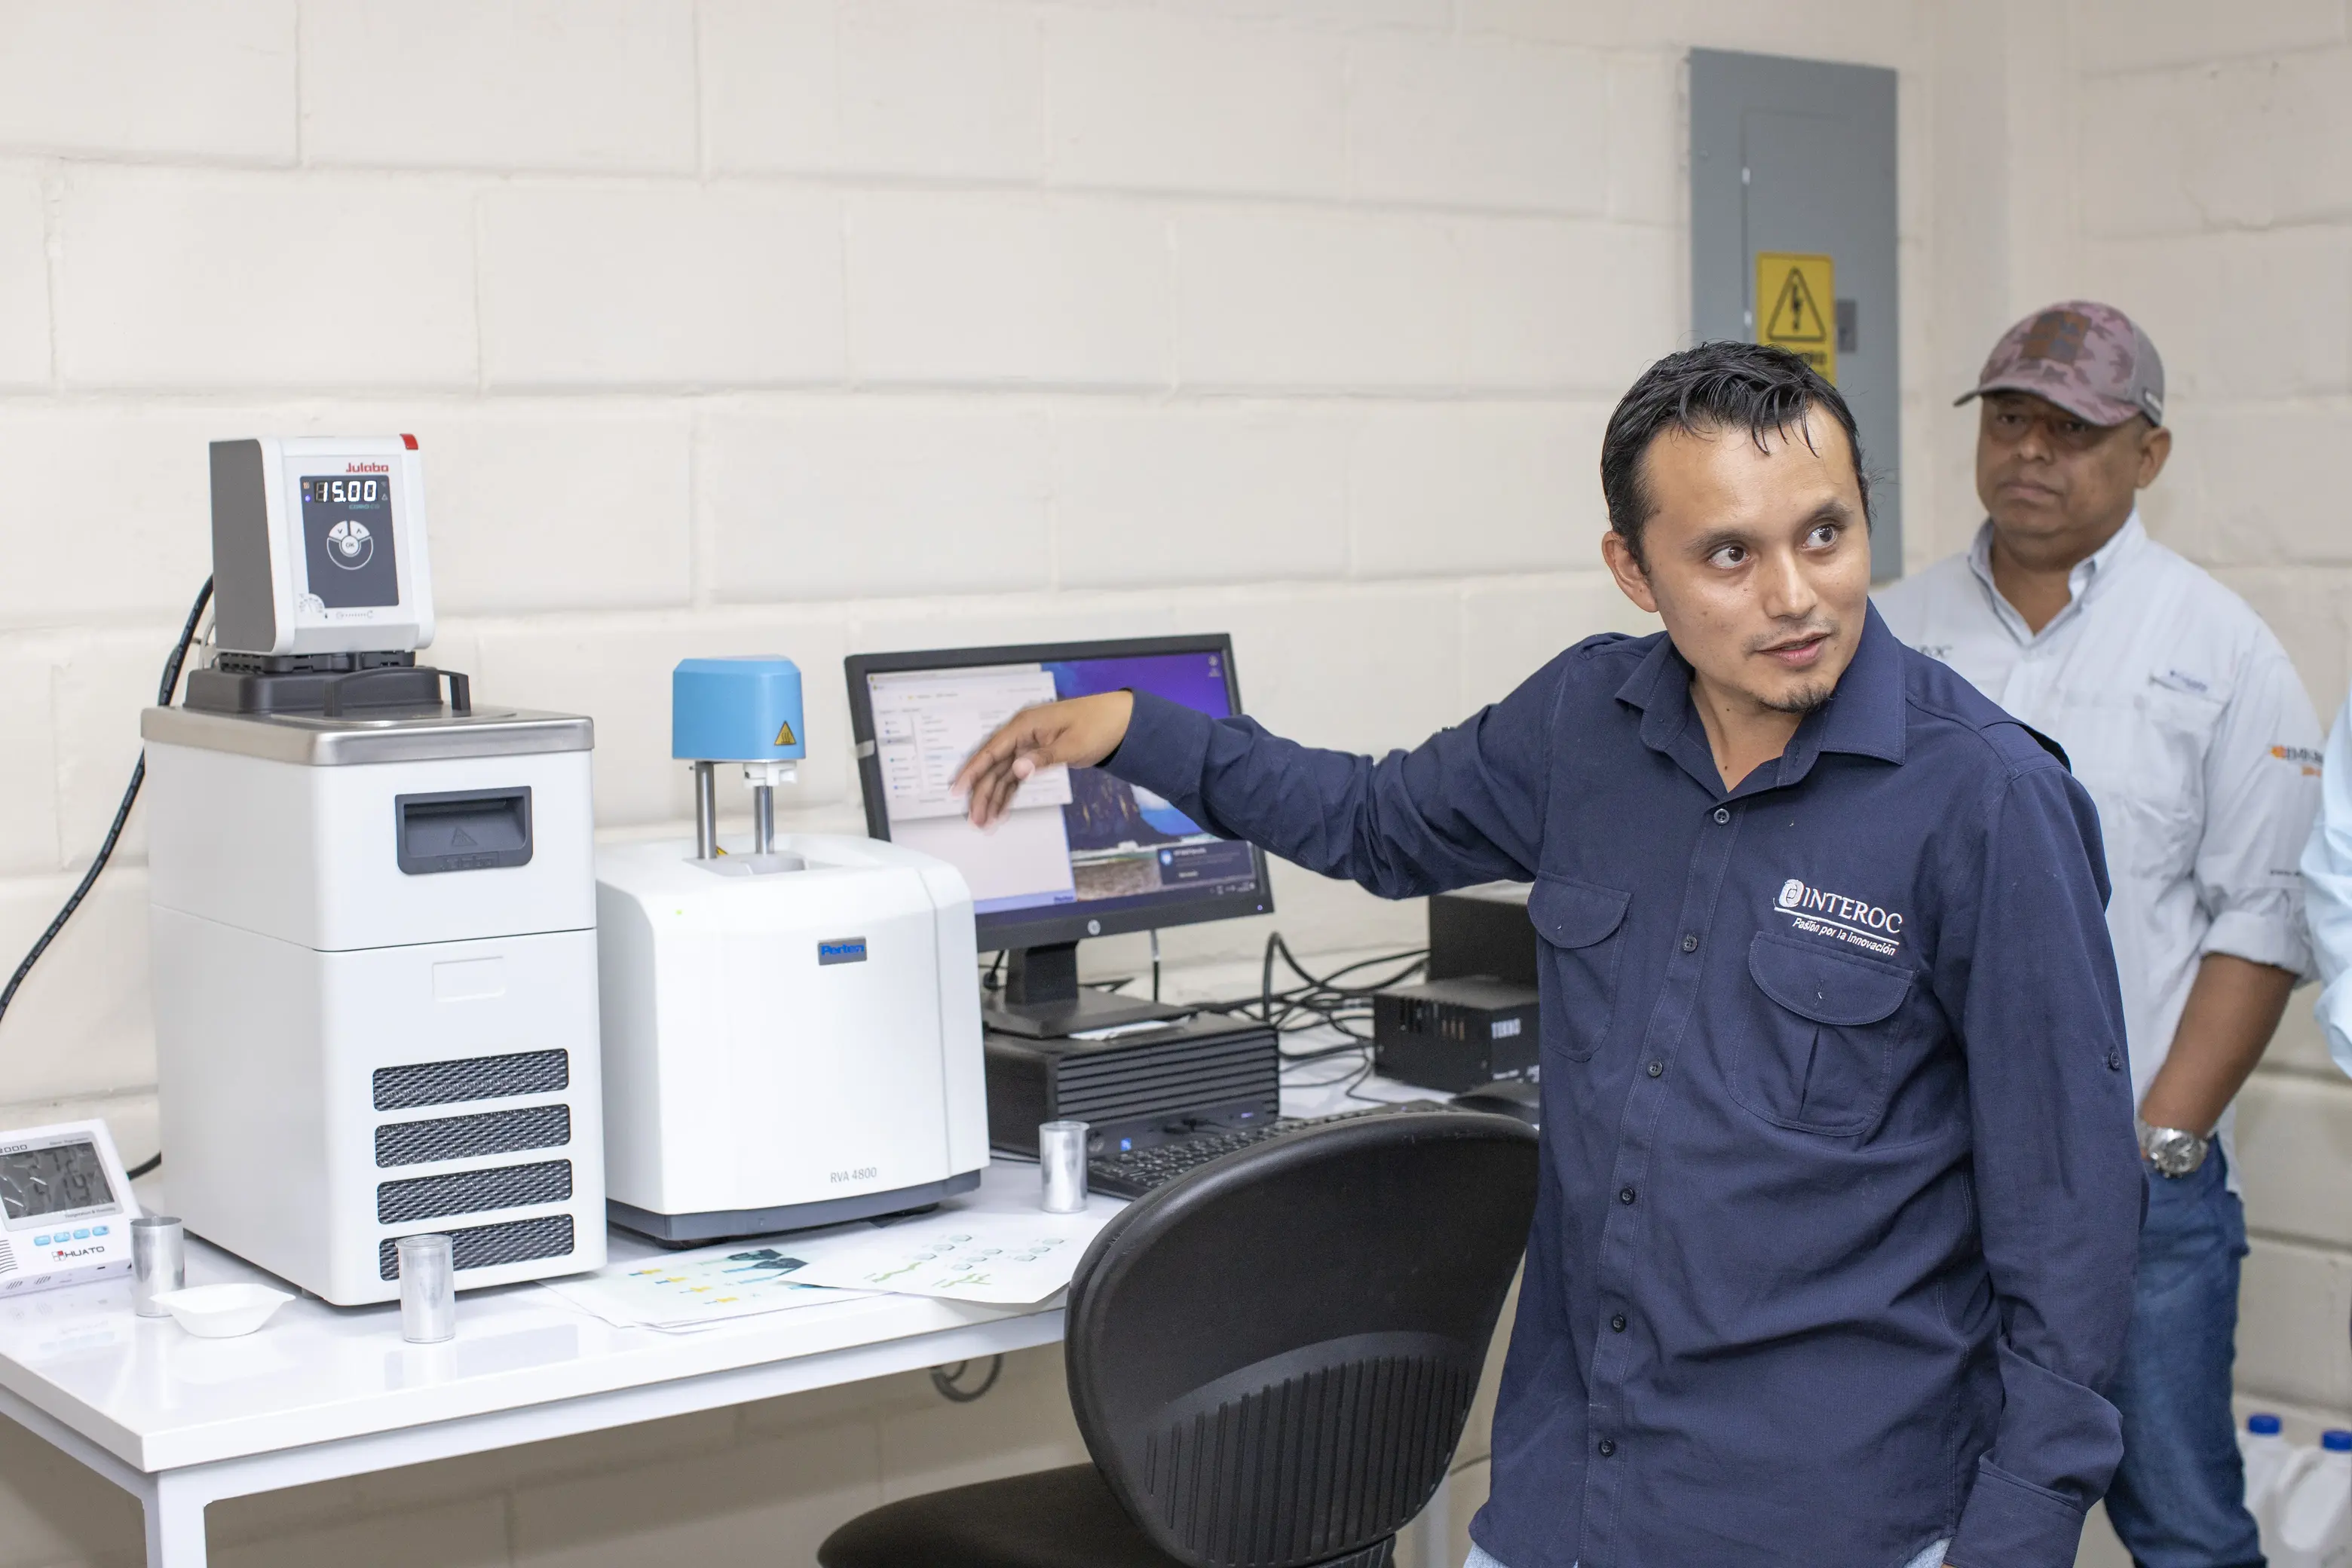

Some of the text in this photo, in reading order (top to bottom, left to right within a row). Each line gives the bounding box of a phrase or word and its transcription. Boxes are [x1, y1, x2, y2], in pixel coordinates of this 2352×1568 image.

[346, 462, 389, 473] Julabo
[323, 480, 377, 503] 15.00
[1802, 887, 1903, 934] INTEROC
[1818, 926, 1836, 937] por
[1836, 929, 1848, 941] la
[1847, 932, 1896, 956] innovación
[830, 1167, 877, 1183] RVA 4800
[64, 1246, 105, 1257] HUATO
